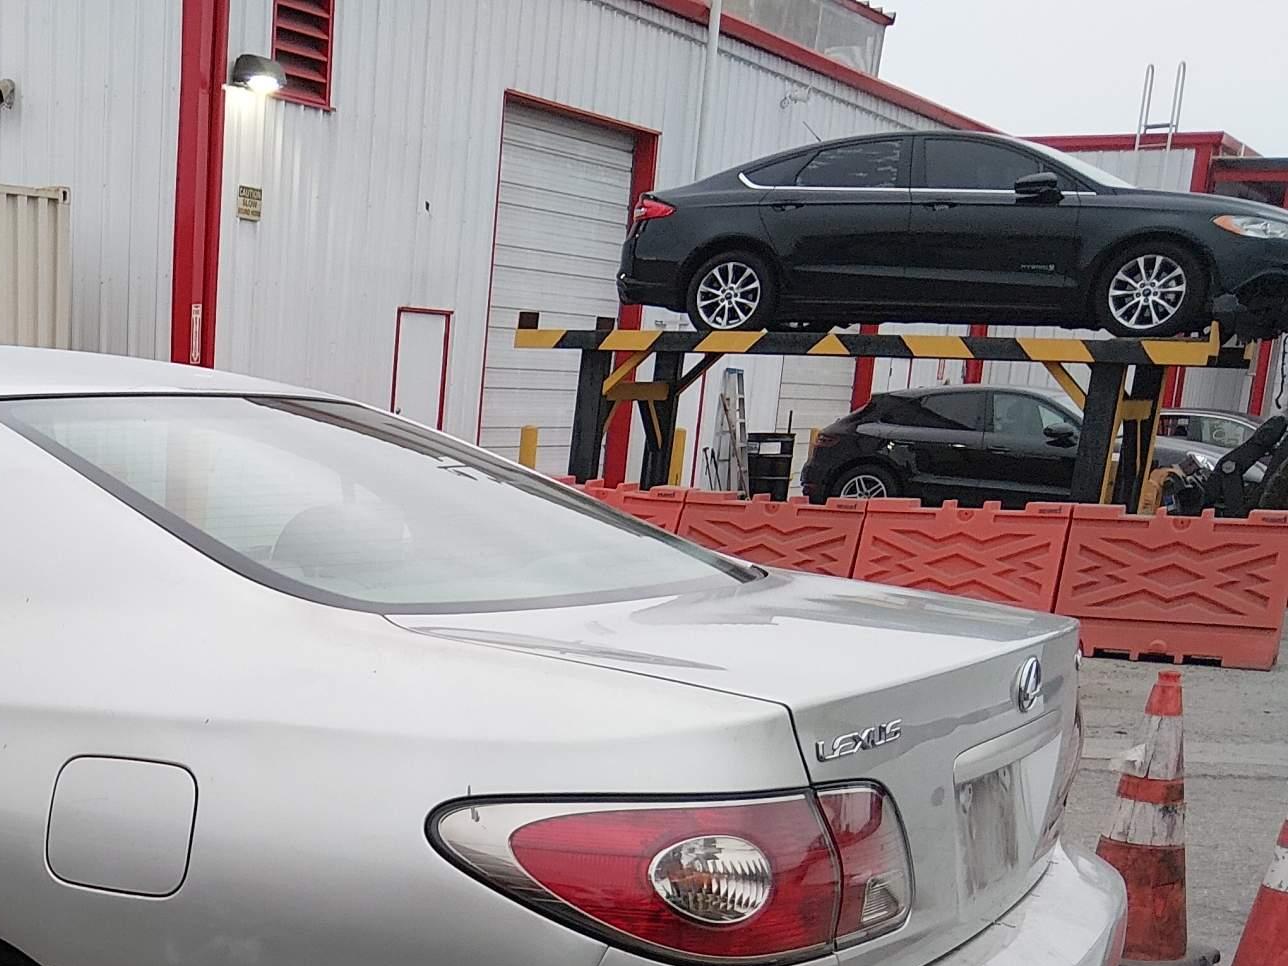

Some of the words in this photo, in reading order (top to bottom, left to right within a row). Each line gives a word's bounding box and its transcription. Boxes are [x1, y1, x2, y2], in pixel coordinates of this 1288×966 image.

[239, 186, 262, 200] CAUTION
[242, 199, 258, 208] SLOW
[815, 718, 902, 762] LEXUS
